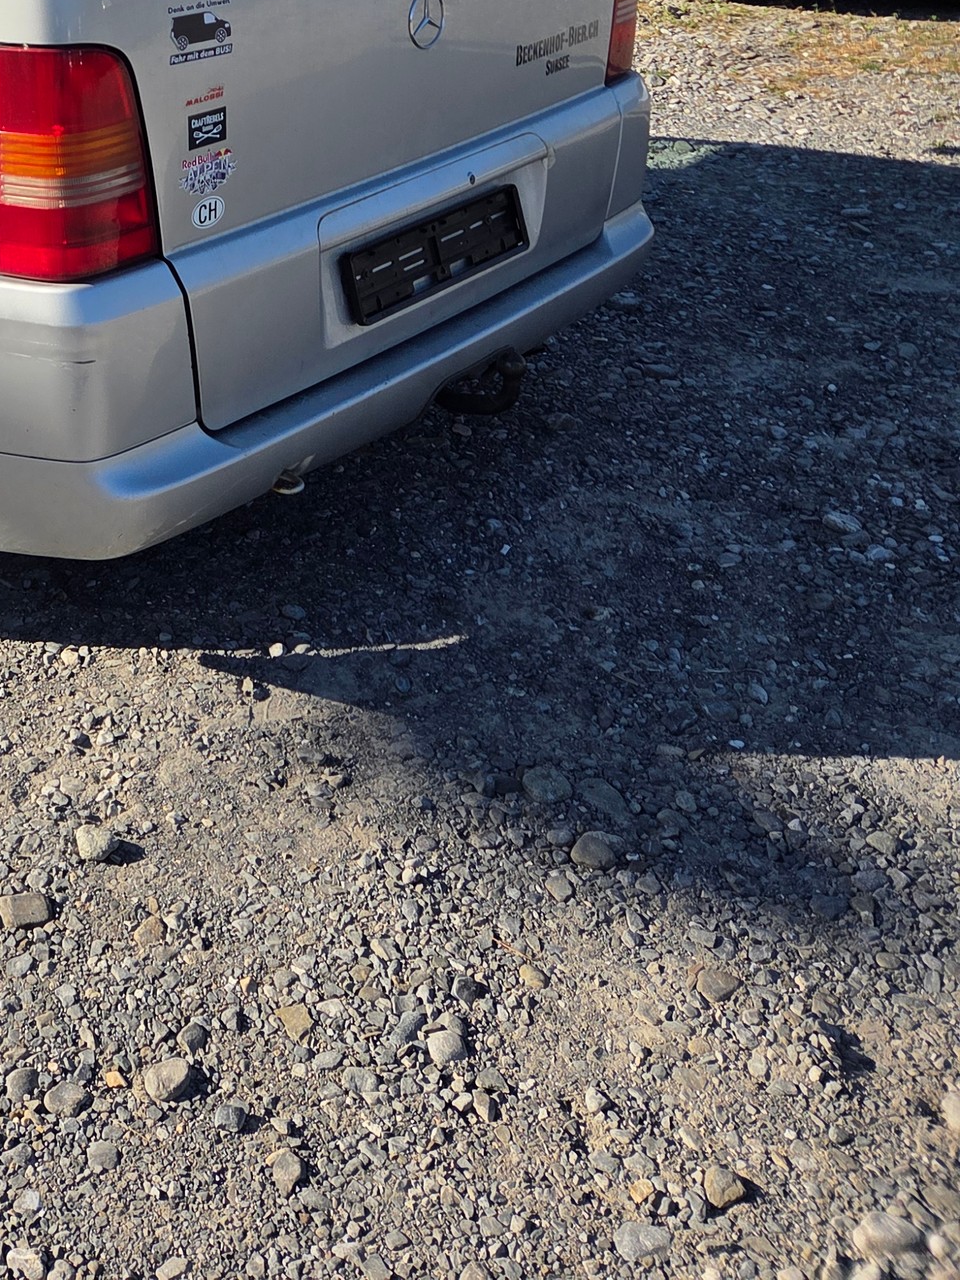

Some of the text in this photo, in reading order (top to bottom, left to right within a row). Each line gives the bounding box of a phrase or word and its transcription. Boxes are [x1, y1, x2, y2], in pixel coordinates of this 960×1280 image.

[195, 1, 205, 9] die
[170, 45, 232, 64] Fahr mit dem BUS!
[185, 90, 224, 106] MALOSSI
[182, 156, 197, 169] Red
[198, 200, 218, 224] CH
